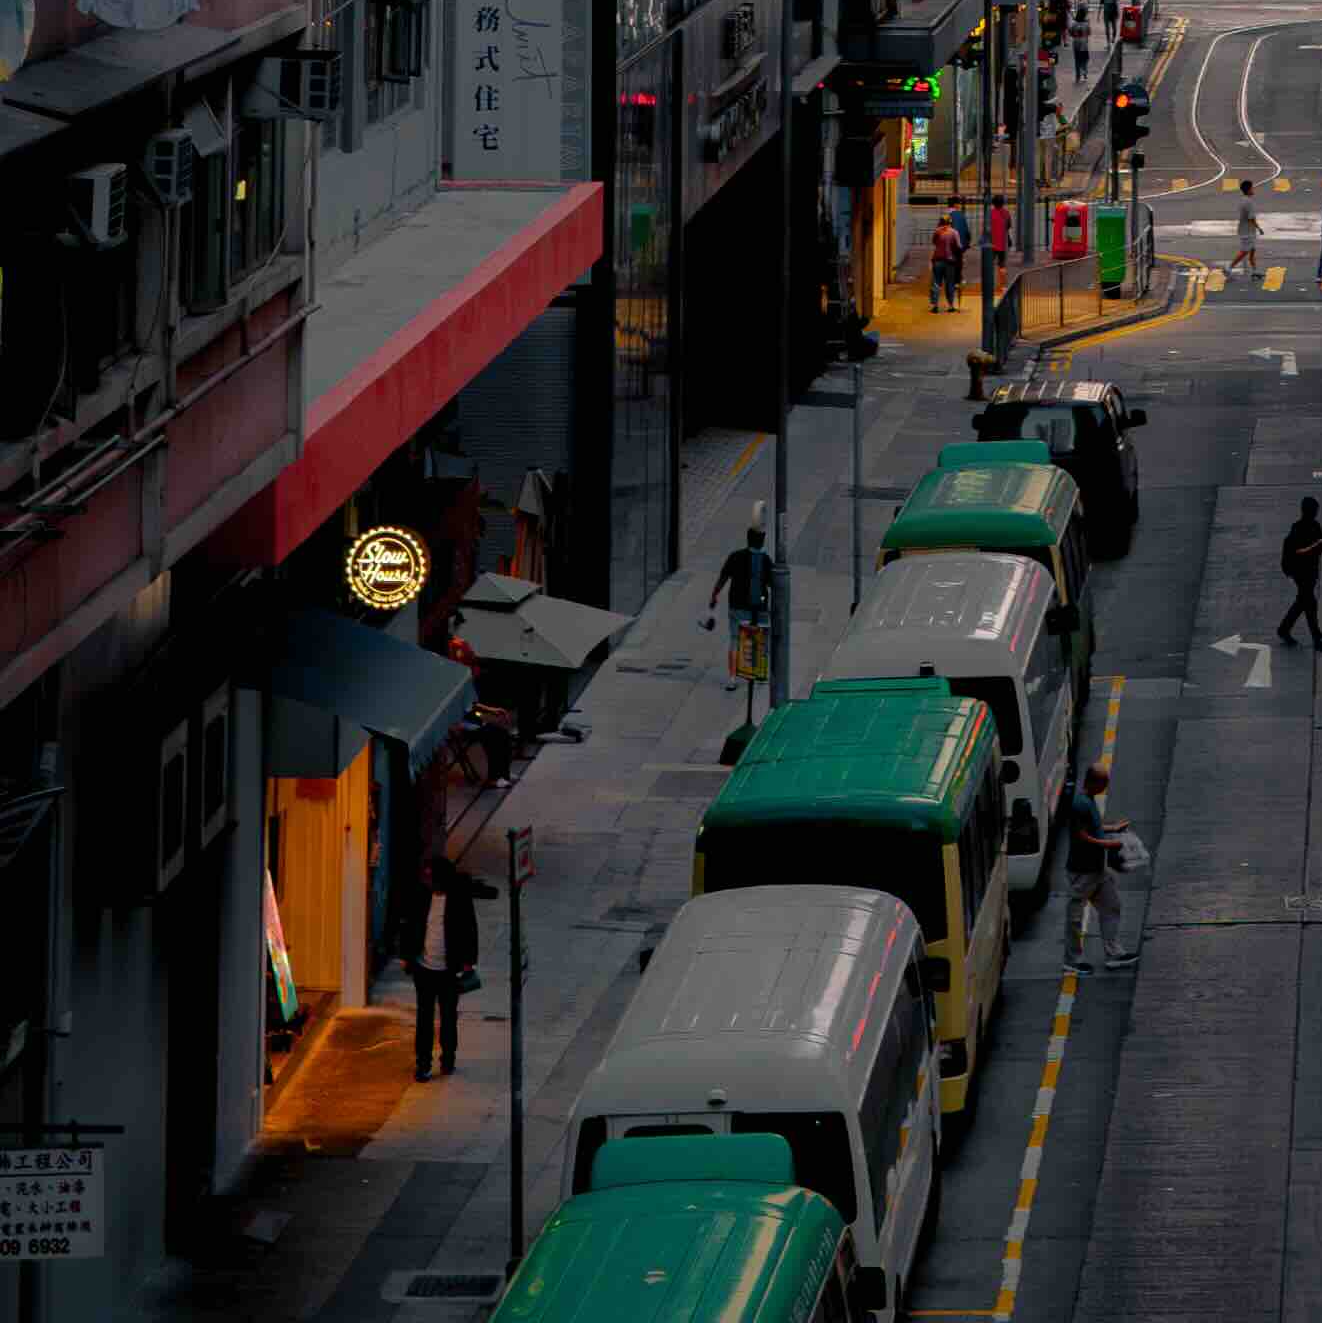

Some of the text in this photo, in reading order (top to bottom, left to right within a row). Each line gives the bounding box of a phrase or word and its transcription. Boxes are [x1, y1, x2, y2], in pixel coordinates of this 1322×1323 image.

[357, 541, 409, 564] Slow
[361, 562, 410, 584] House
[28, 1237, 71, 1255] 6932
